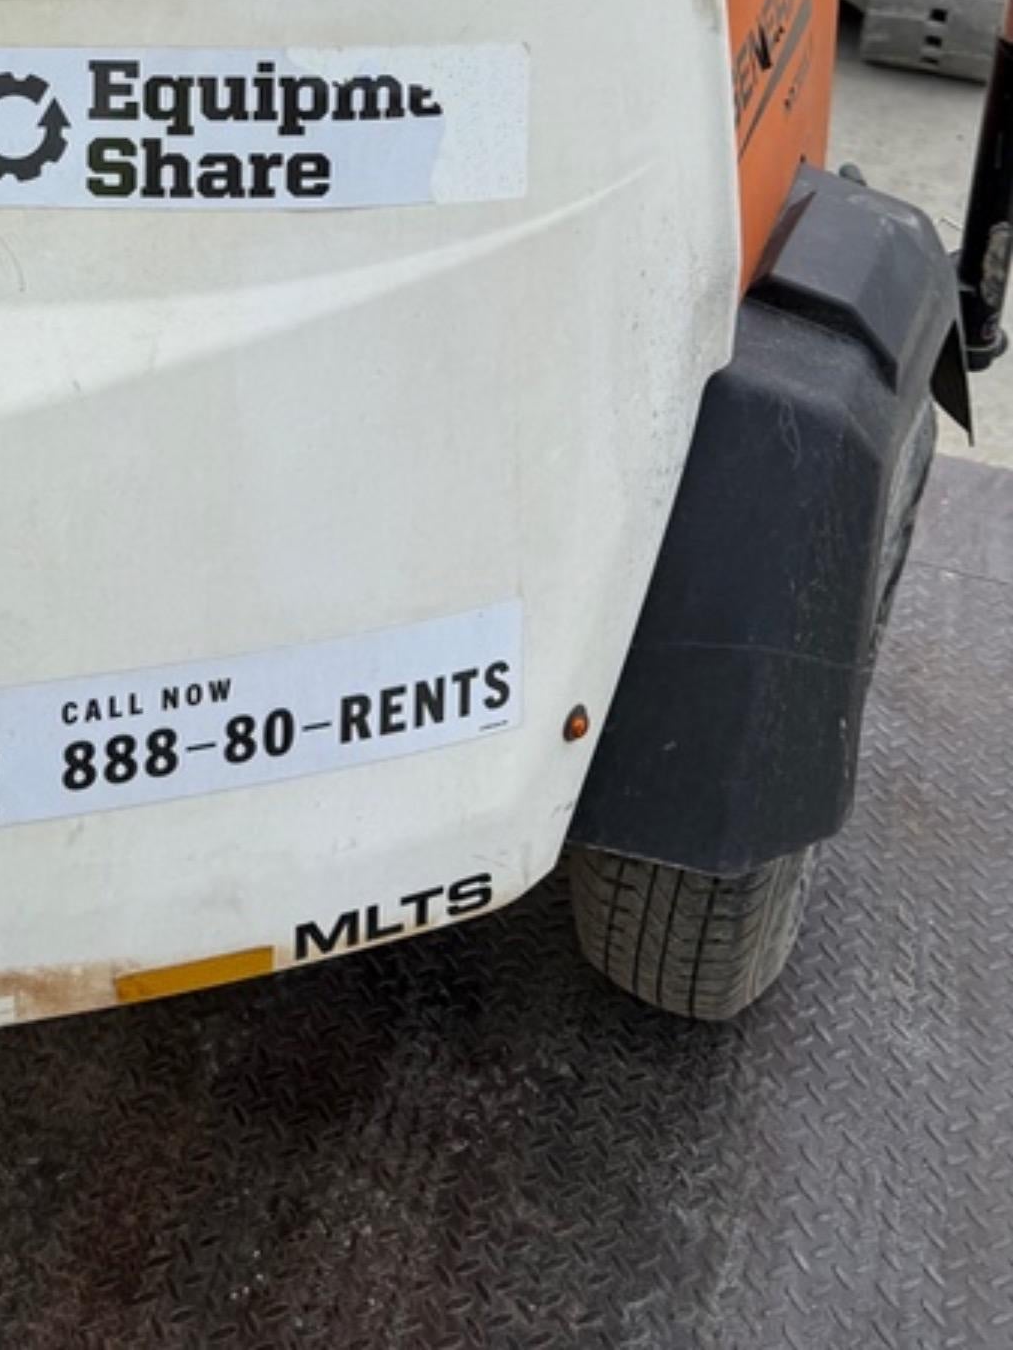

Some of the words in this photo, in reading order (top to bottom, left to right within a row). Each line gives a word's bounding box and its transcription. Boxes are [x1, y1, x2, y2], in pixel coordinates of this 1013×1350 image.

[86, 136, 330, 199] Share
[61, 692, 144, 725] CALL
[161, 677, 233, 712] NOW
[295, 872, 493, 961] MLTS
